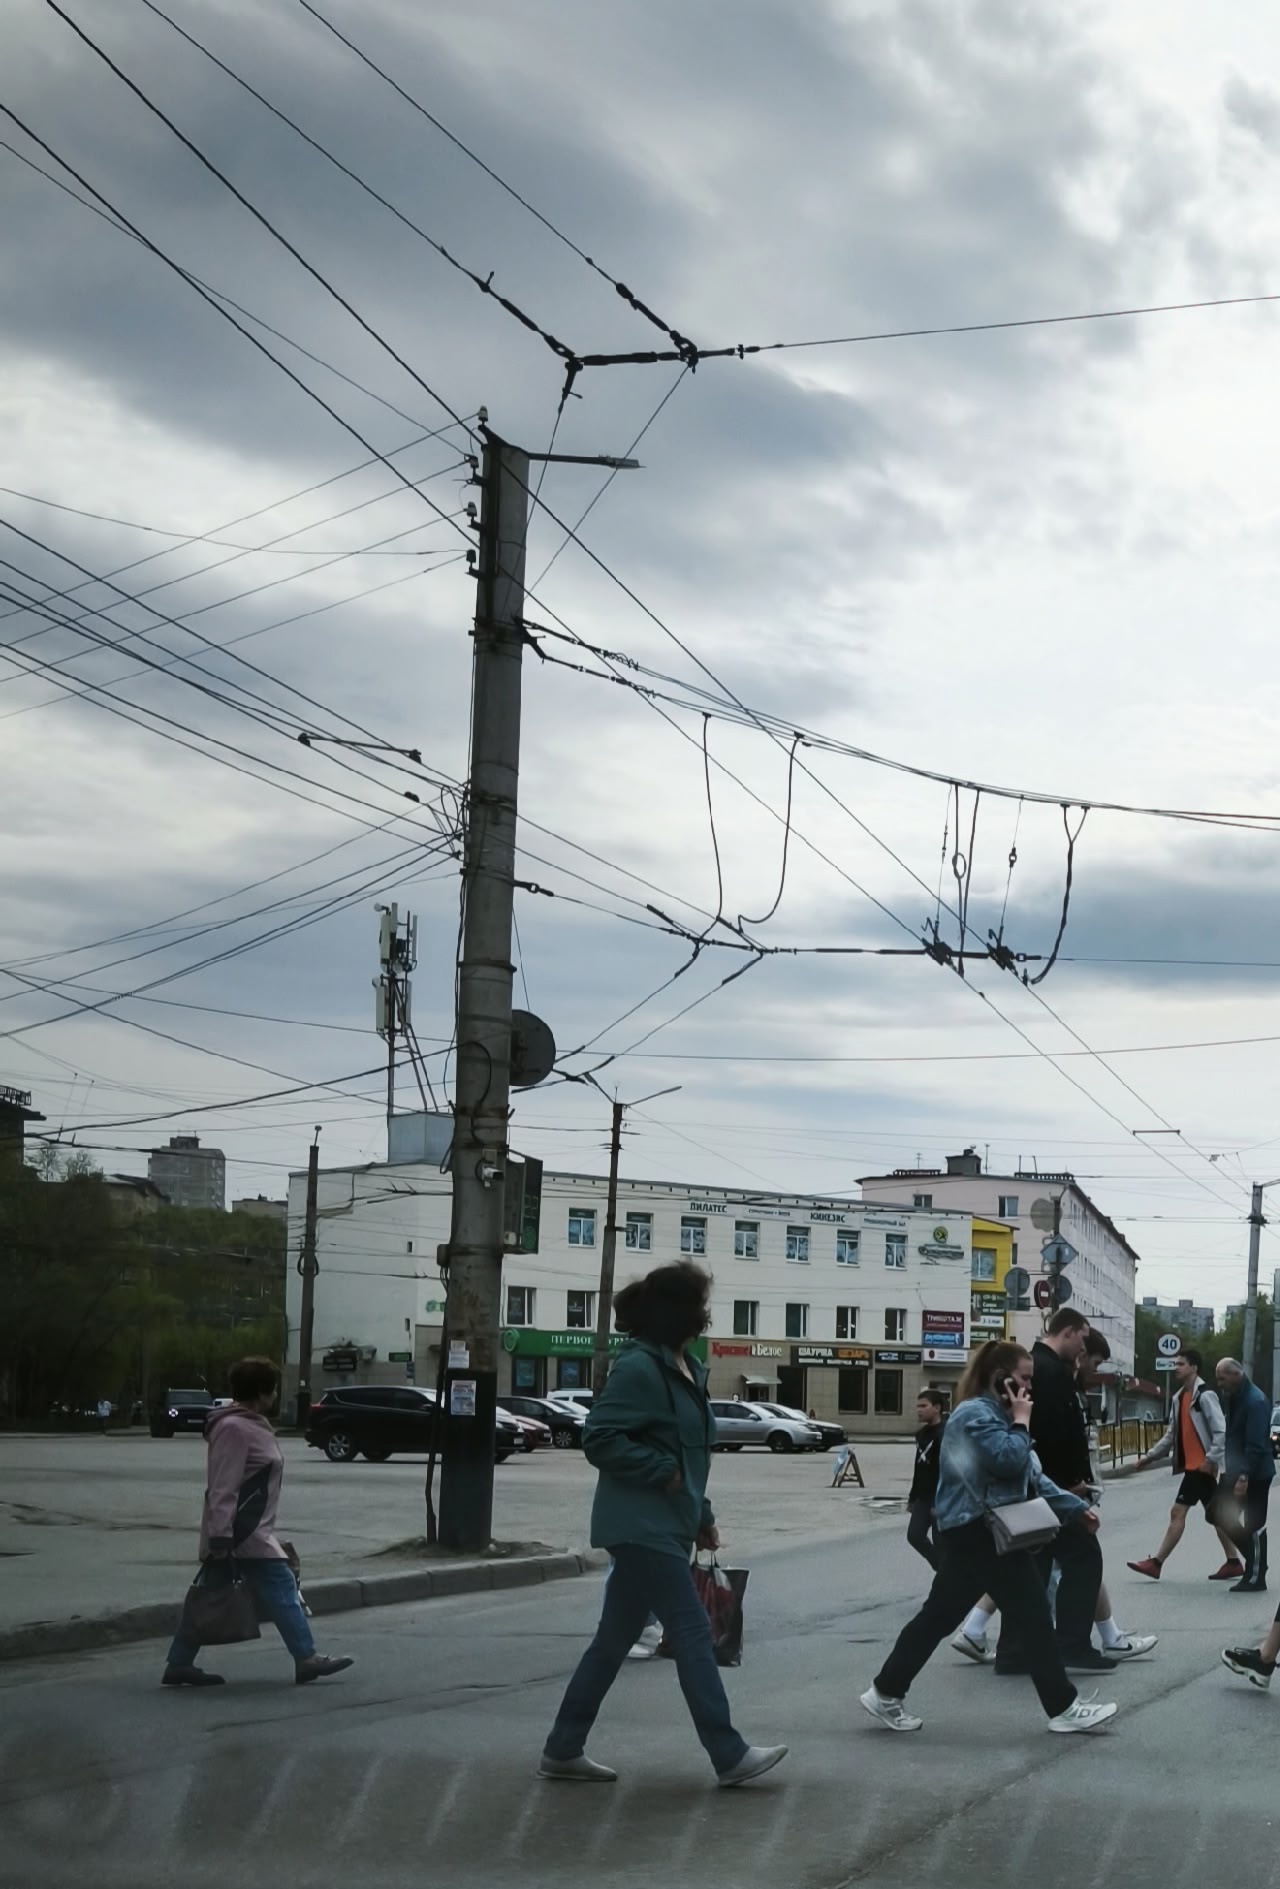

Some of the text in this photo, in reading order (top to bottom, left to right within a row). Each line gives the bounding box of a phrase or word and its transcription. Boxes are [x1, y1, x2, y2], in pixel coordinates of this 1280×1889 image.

[690, 1202, 727, 1213] ПИЛАТЕС
[810, 1212, 846, 1223] КИНЕЗИС
[1161, 1338, 1177, 1350] 40
